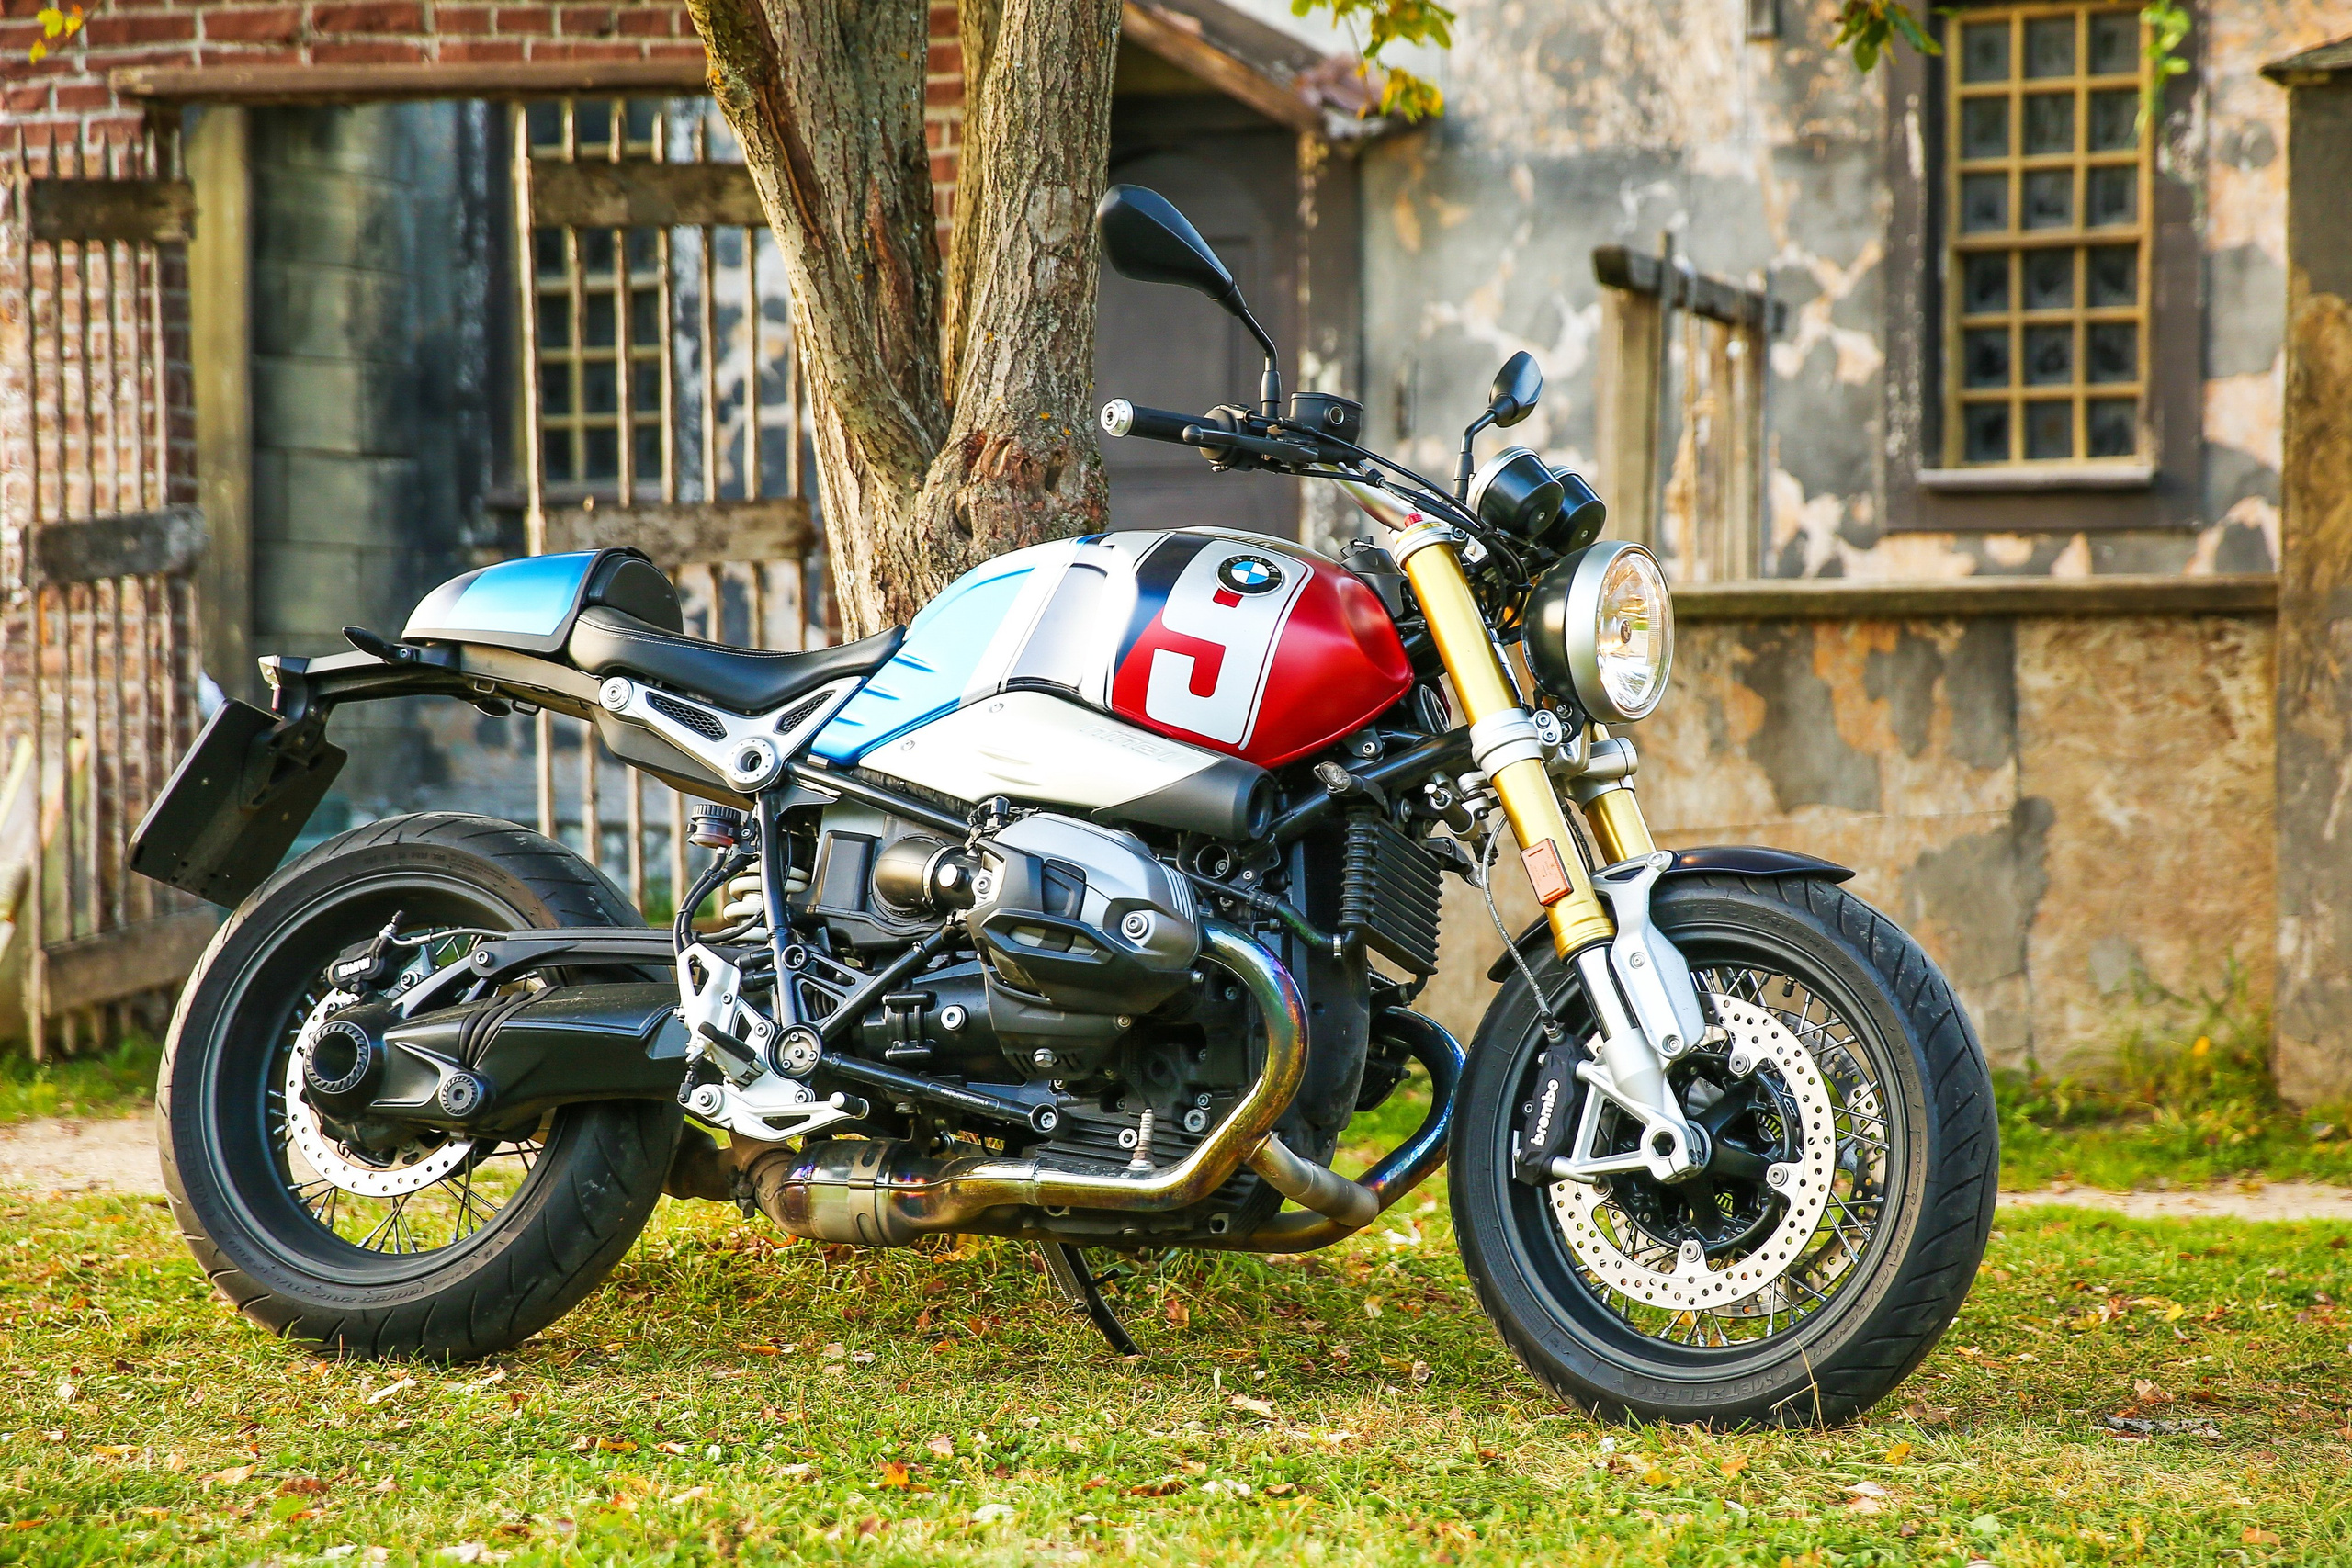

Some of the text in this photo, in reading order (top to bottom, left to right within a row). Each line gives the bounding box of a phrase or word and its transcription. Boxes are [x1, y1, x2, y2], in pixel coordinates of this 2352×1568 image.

[1230, 556, 1279, 574] BMW
[337, 956, 371, 978] BMW
[1530, 1078, 1560, 1147] brembo
[1651, 1372, 1773, 1403] METZELER
